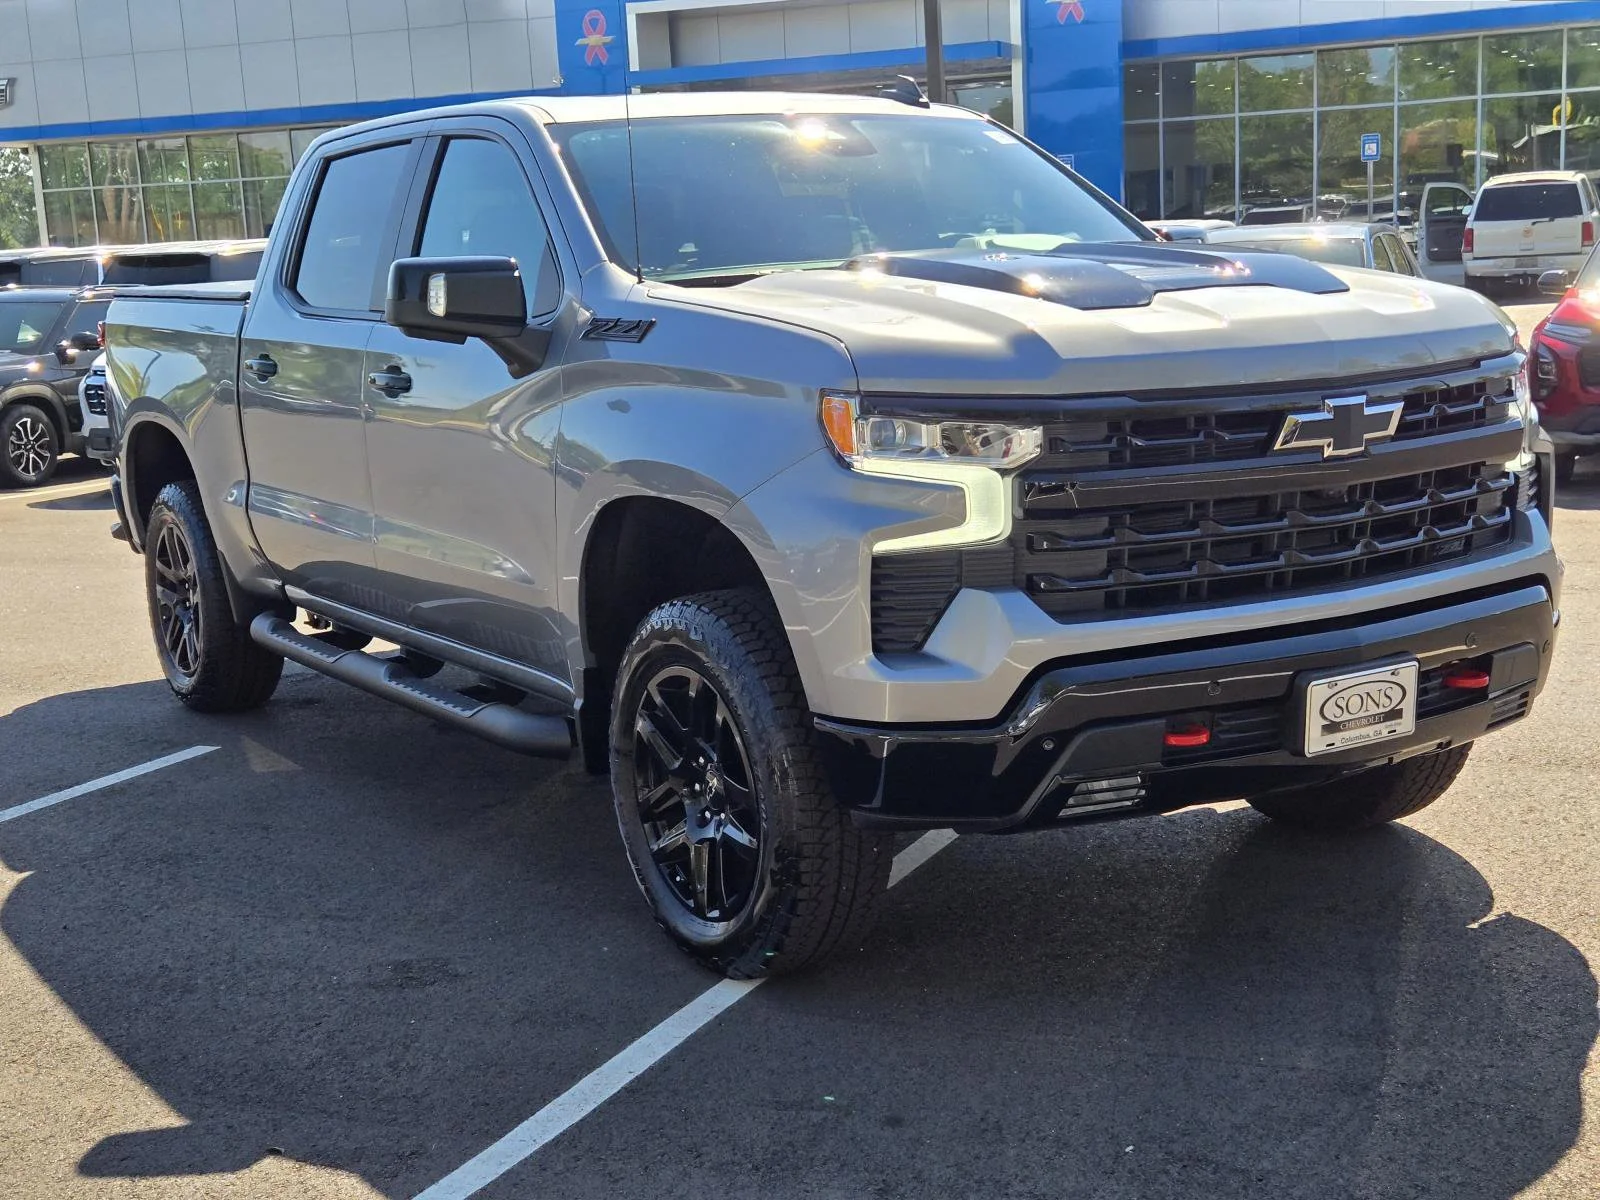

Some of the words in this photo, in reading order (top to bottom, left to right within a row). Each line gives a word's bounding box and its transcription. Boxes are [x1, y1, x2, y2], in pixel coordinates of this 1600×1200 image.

[1333, 686, 1393, 719] SONS
[1340, 714, 1385, 730] CHEVROLET
[1373, 729, 1383, 737] GA
